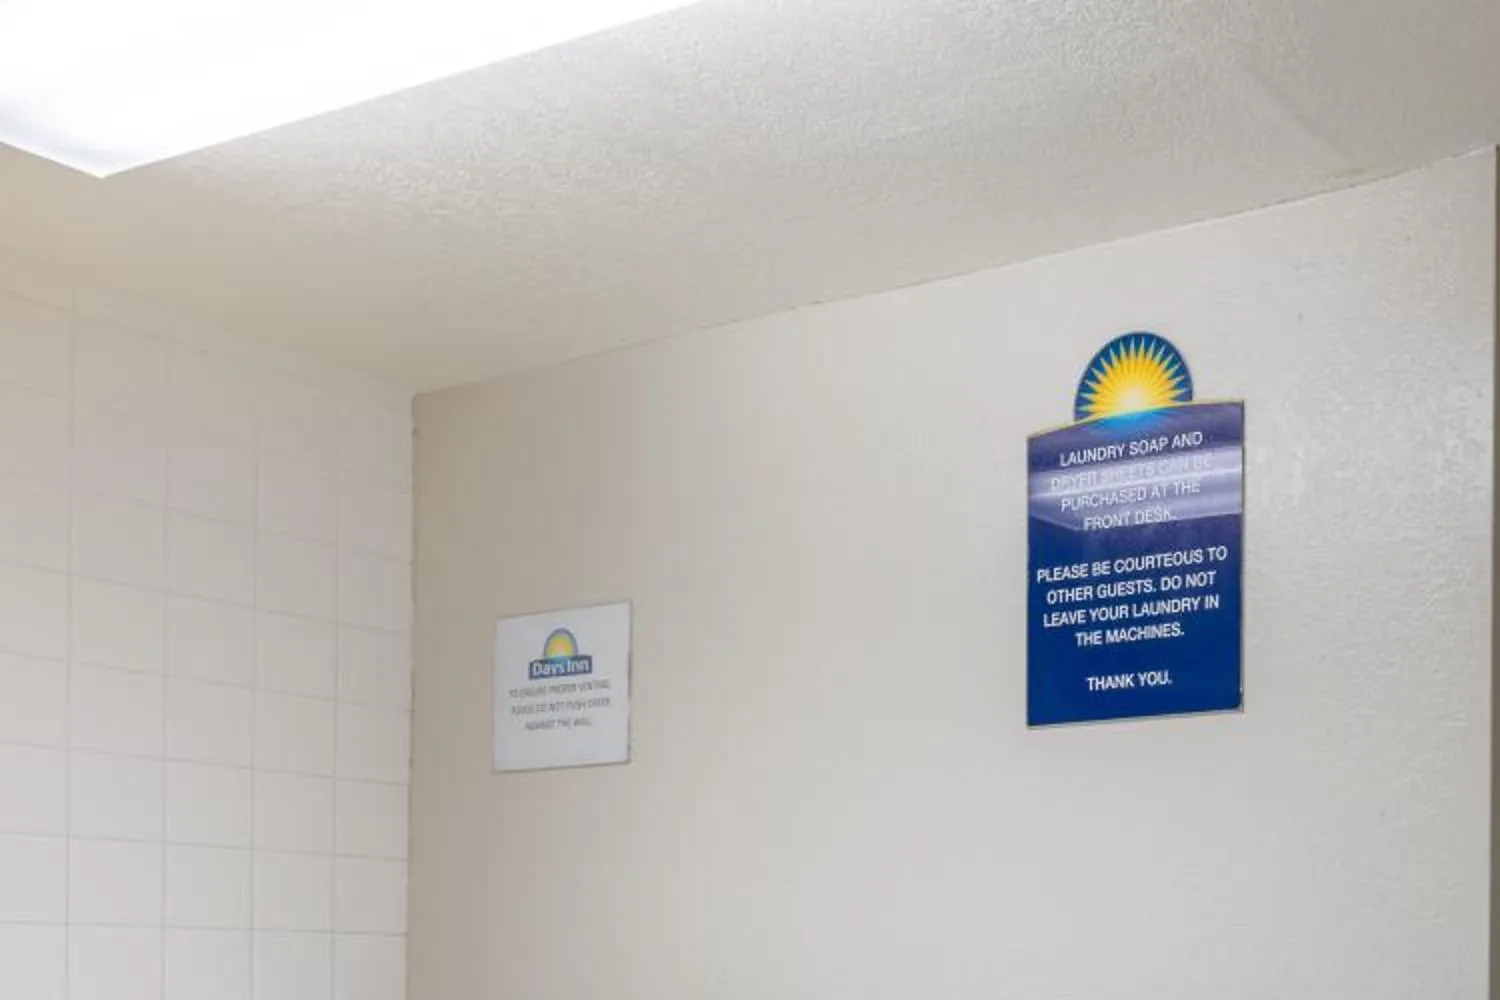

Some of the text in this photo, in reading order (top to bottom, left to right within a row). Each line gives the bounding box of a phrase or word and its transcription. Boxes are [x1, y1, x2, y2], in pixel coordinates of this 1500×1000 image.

[1060, 431, 1203, 467] LAUNDRY SOAP AND
[1061, 480, 1201, 512] PURCHASED AT THE
[1084, 511, 1130, 530] FRONT
[1037, 545, 1228, 584] PLEASE BE COURTEOUS TO
[1047, 570, 1216, 604] OTHER GUESTS. DO NOT
[1043, 594, 1219, 628] LEAVE YOUR LAUNDRY IN
[1075, 622, 1185, 647] THE MACHINES.
[533, 659, 589, 677] Days Inn
[1087, 670, 1173, 691] THANK YOU.
